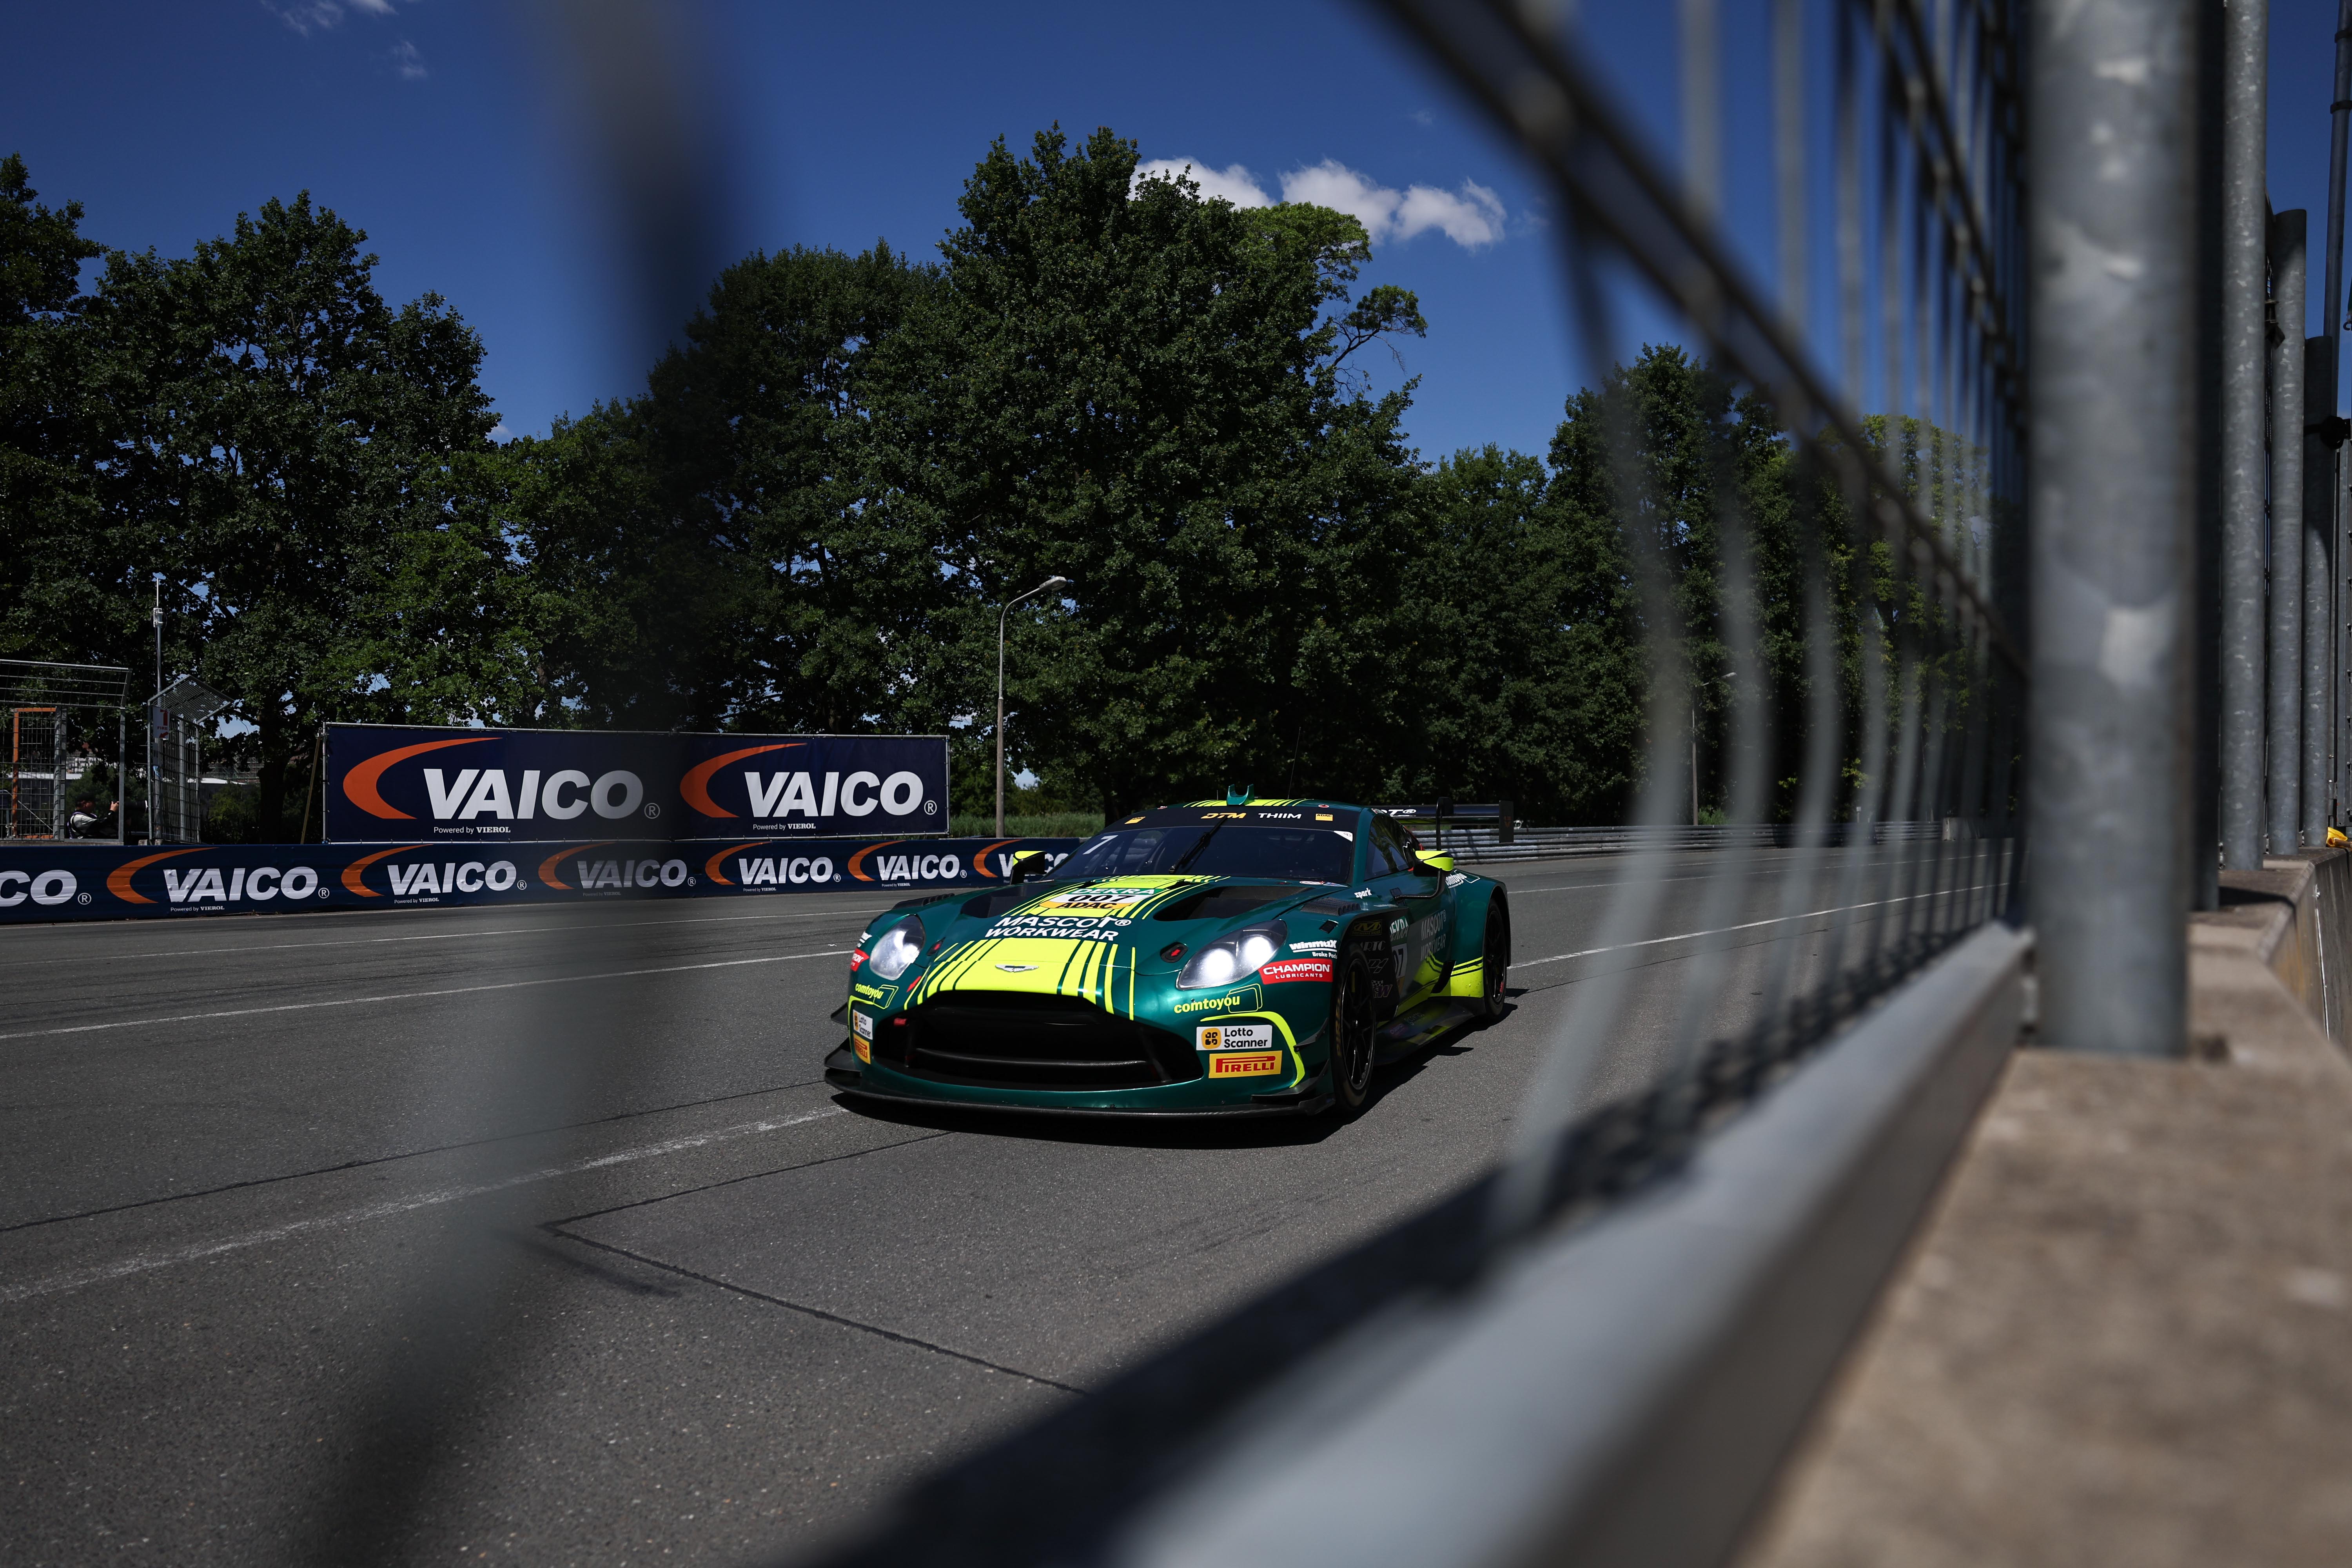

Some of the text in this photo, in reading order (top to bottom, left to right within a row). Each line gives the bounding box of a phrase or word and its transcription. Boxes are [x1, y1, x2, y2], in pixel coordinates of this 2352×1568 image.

[466, 827, 474, 835] by
[1354, 887, 1372, 899] spark
[984, 926, 1119, 941] WORKWEAR
[1263, 963, 1330, 975] CHAMPION
[855, 983, 884, 999] comtoyou
[1174, 996, 1240, 1013] comtoyou
[1224, 1027, 1253, 1037] Lotto
[1224, 1039, 1268, 1048] Scanner
[1216, 1056, 1276, 1073] PIRELLI
